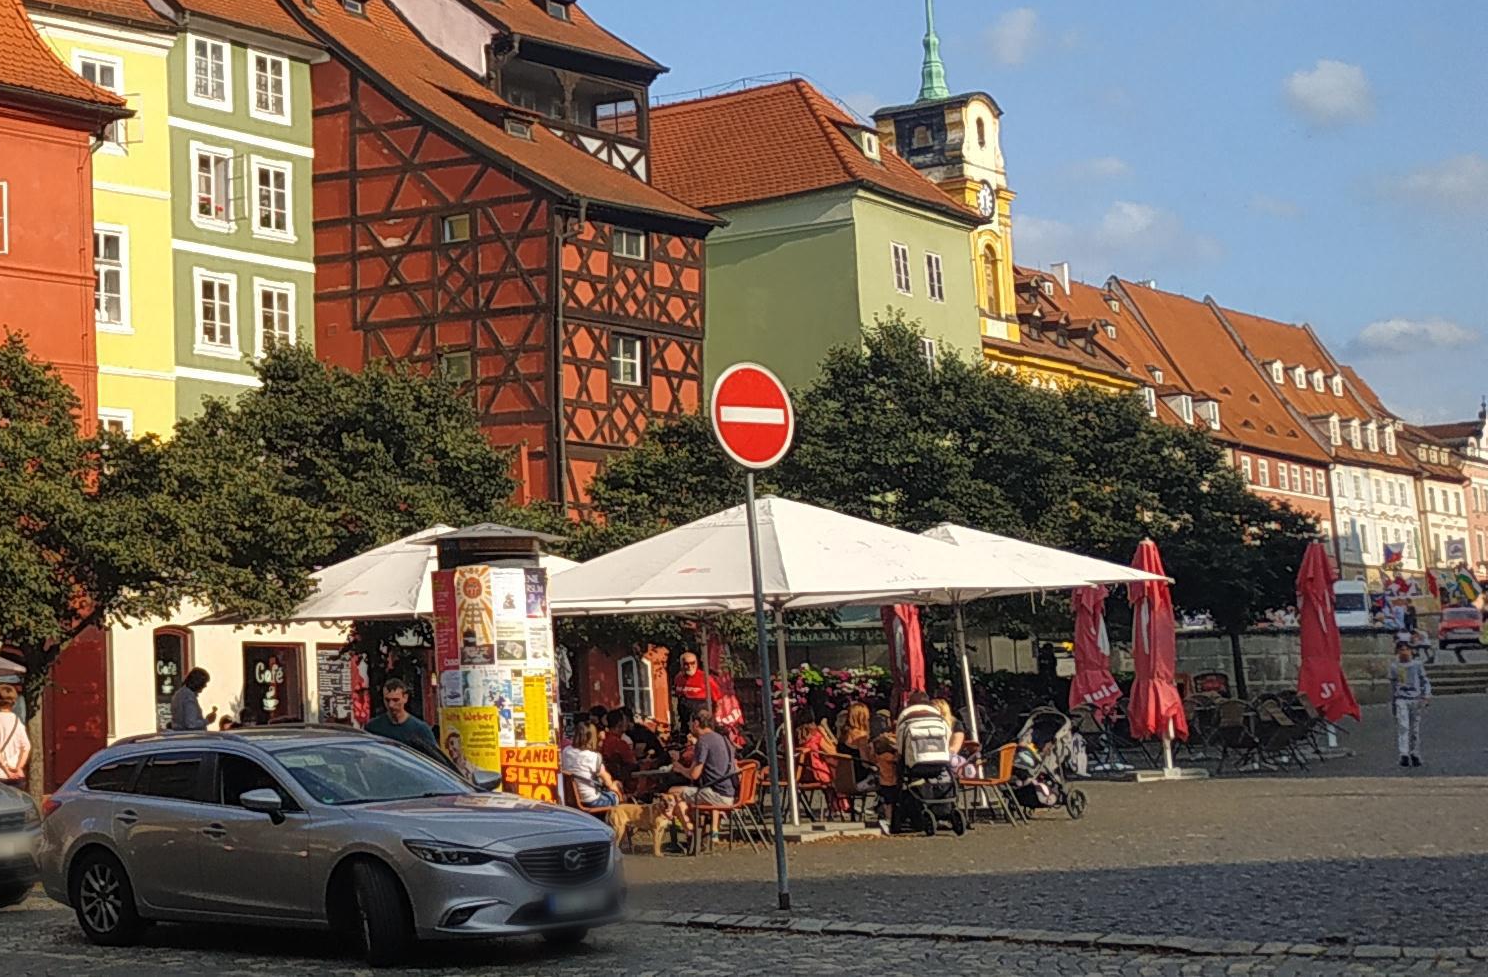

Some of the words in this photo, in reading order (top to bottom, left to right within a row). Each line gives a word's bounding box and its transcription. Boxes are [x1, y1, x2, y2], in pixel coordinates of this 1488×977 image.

[255, 661, 284, 684] Café
[505, 749, 555, 763] PLANEO
[505, 766, 557, 785] SLEVA
